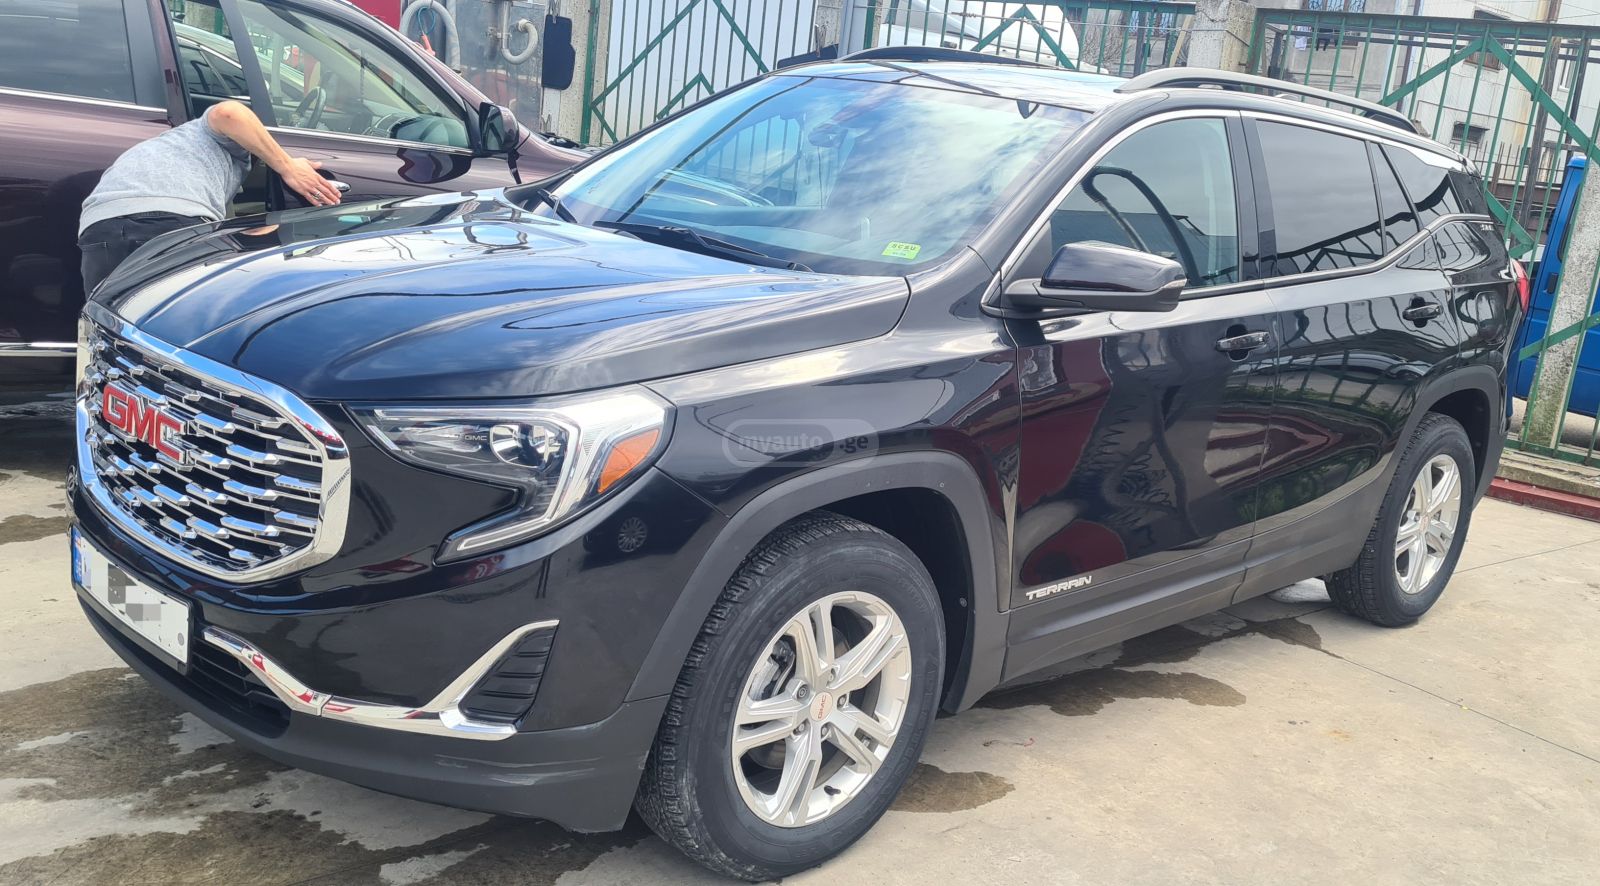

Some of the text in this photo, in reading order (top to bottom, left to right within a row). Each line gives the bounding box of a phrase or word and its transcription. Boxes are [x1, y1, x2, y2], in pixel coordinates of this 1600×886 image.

[103, 383, 185, 463] GMC
[1025, 575, 1092, 601] TERRAIN
[817, 694, 827, 719] GMC
